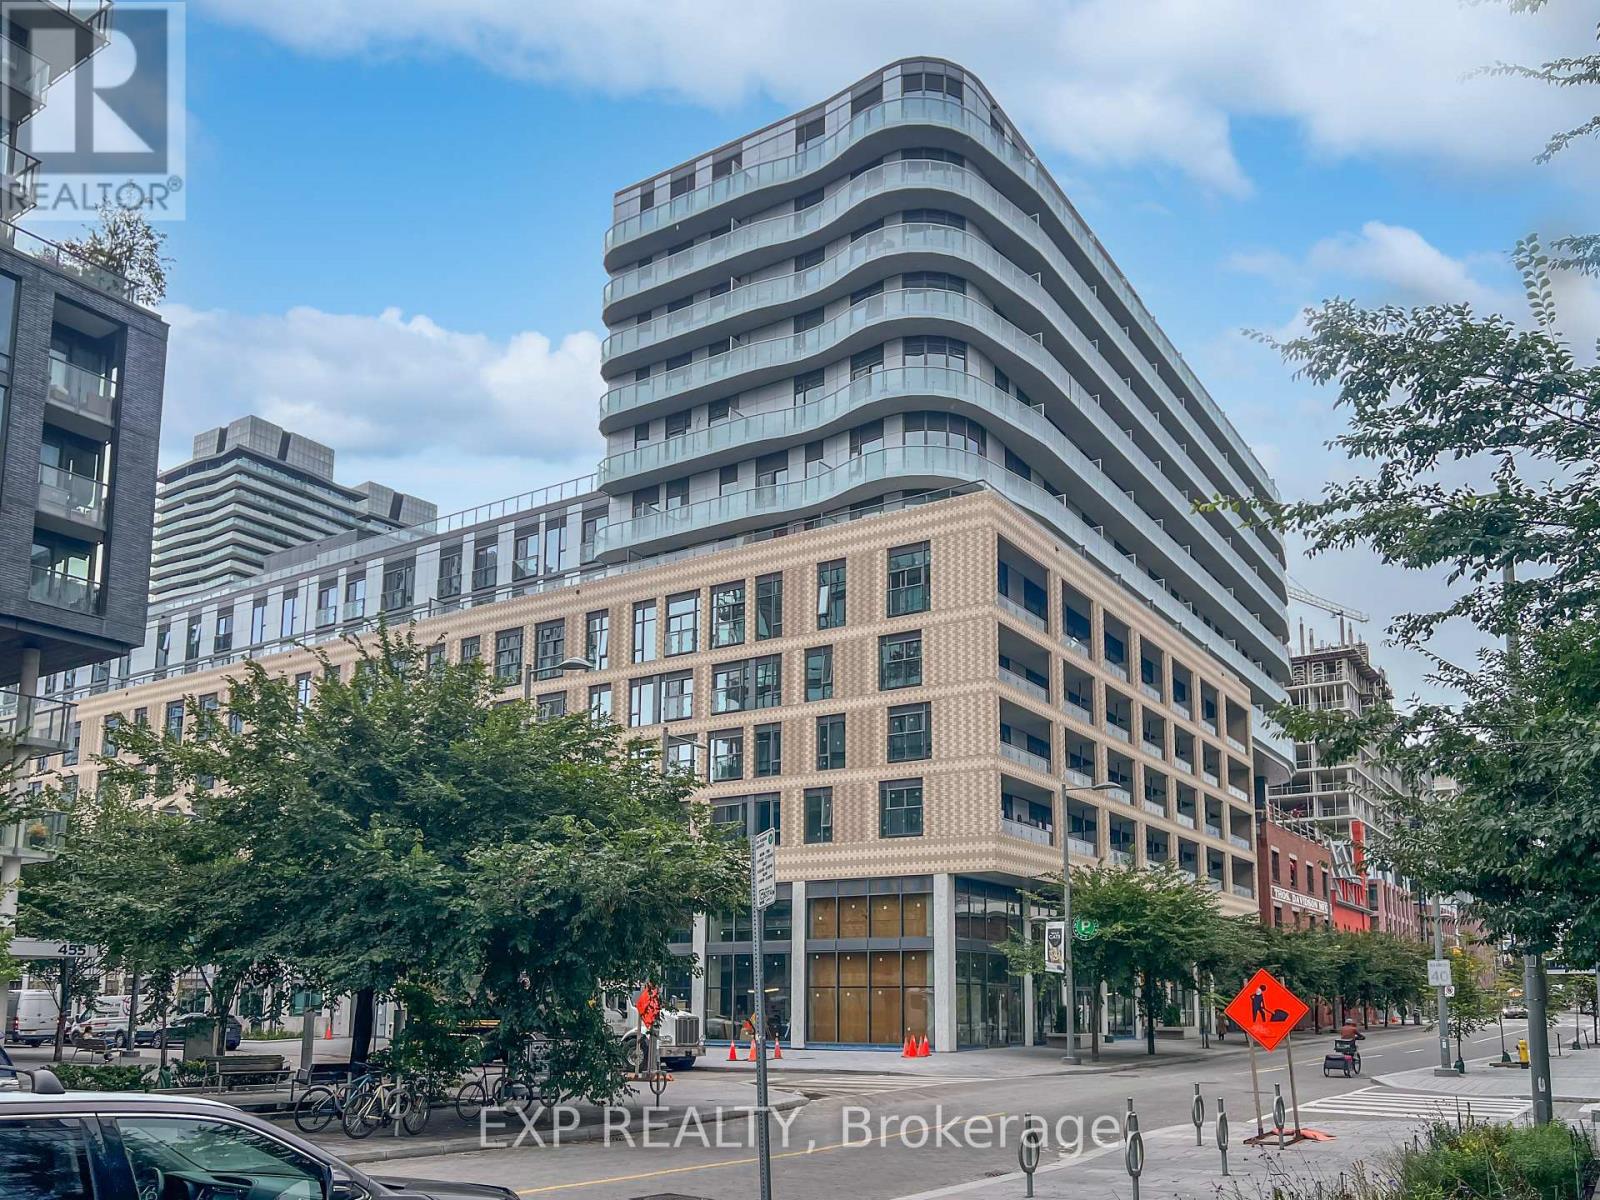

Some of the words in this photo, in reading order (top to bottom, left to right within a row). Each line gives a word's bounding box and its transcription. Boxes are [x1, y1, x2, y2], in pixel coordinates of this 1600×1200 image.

[1292, 894, 1318, 909] DAVIDSON
[57, 944, 86, 956] 455
[1431, 971, 1449, 982] 40
